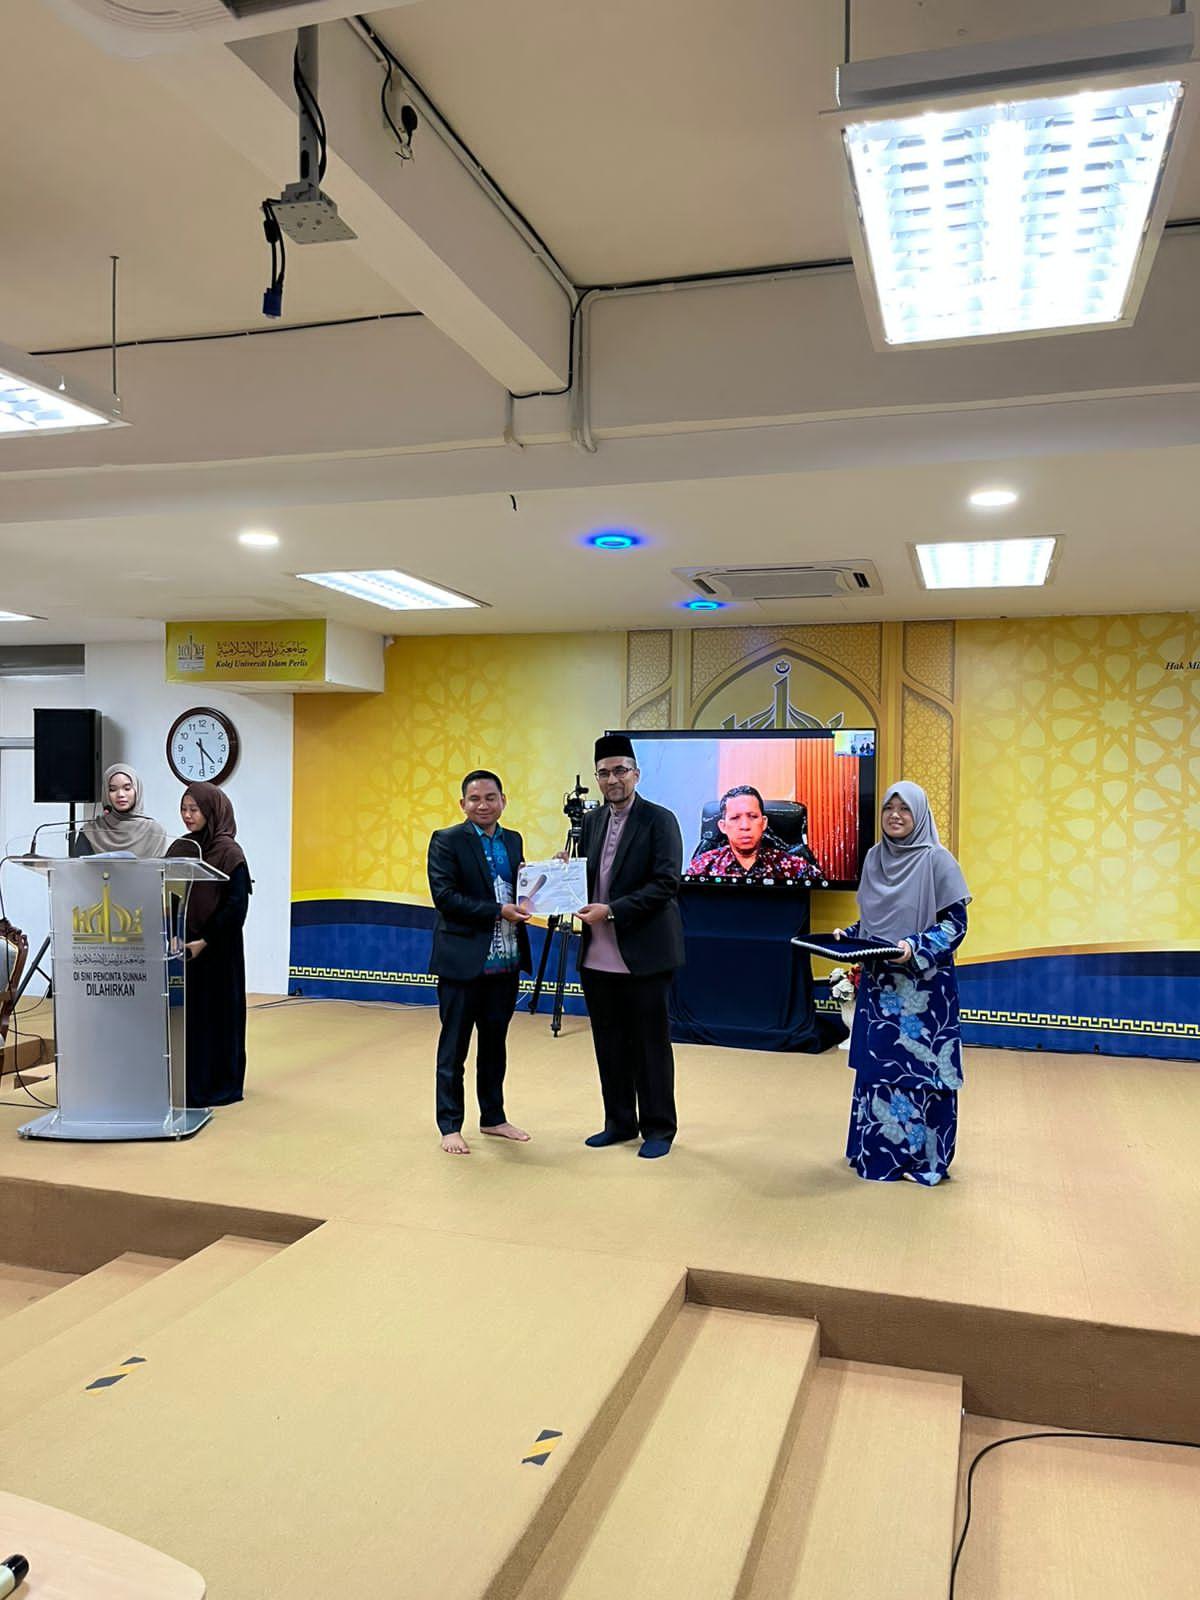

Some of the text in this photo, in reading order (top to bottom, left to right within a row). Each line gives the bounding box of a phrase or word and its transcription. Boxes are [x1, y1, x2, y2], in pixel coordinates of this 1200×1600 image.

[216, 659, 308, 668] Kolej Universiti Islam Perlis
[1165, 662, 1184, 670] Hak
[189, 723, 196, 731] 11
[199, 719, 207, 728] 12
[180, 732, 188, 740] 10
[217, 731, 224, 740] 2
[178, 744, 184, 752] 9
[220, 744, 226, 752] 3
[180, 756, 186, 764] 8
[188, 765, 194, 774] 7
[209, 765, 215, 774] 5
[73, 971, 147, 982] DI SINI PENCINTA SUNNAH
[86, 983, 135, 997] DILAHIRKAN
